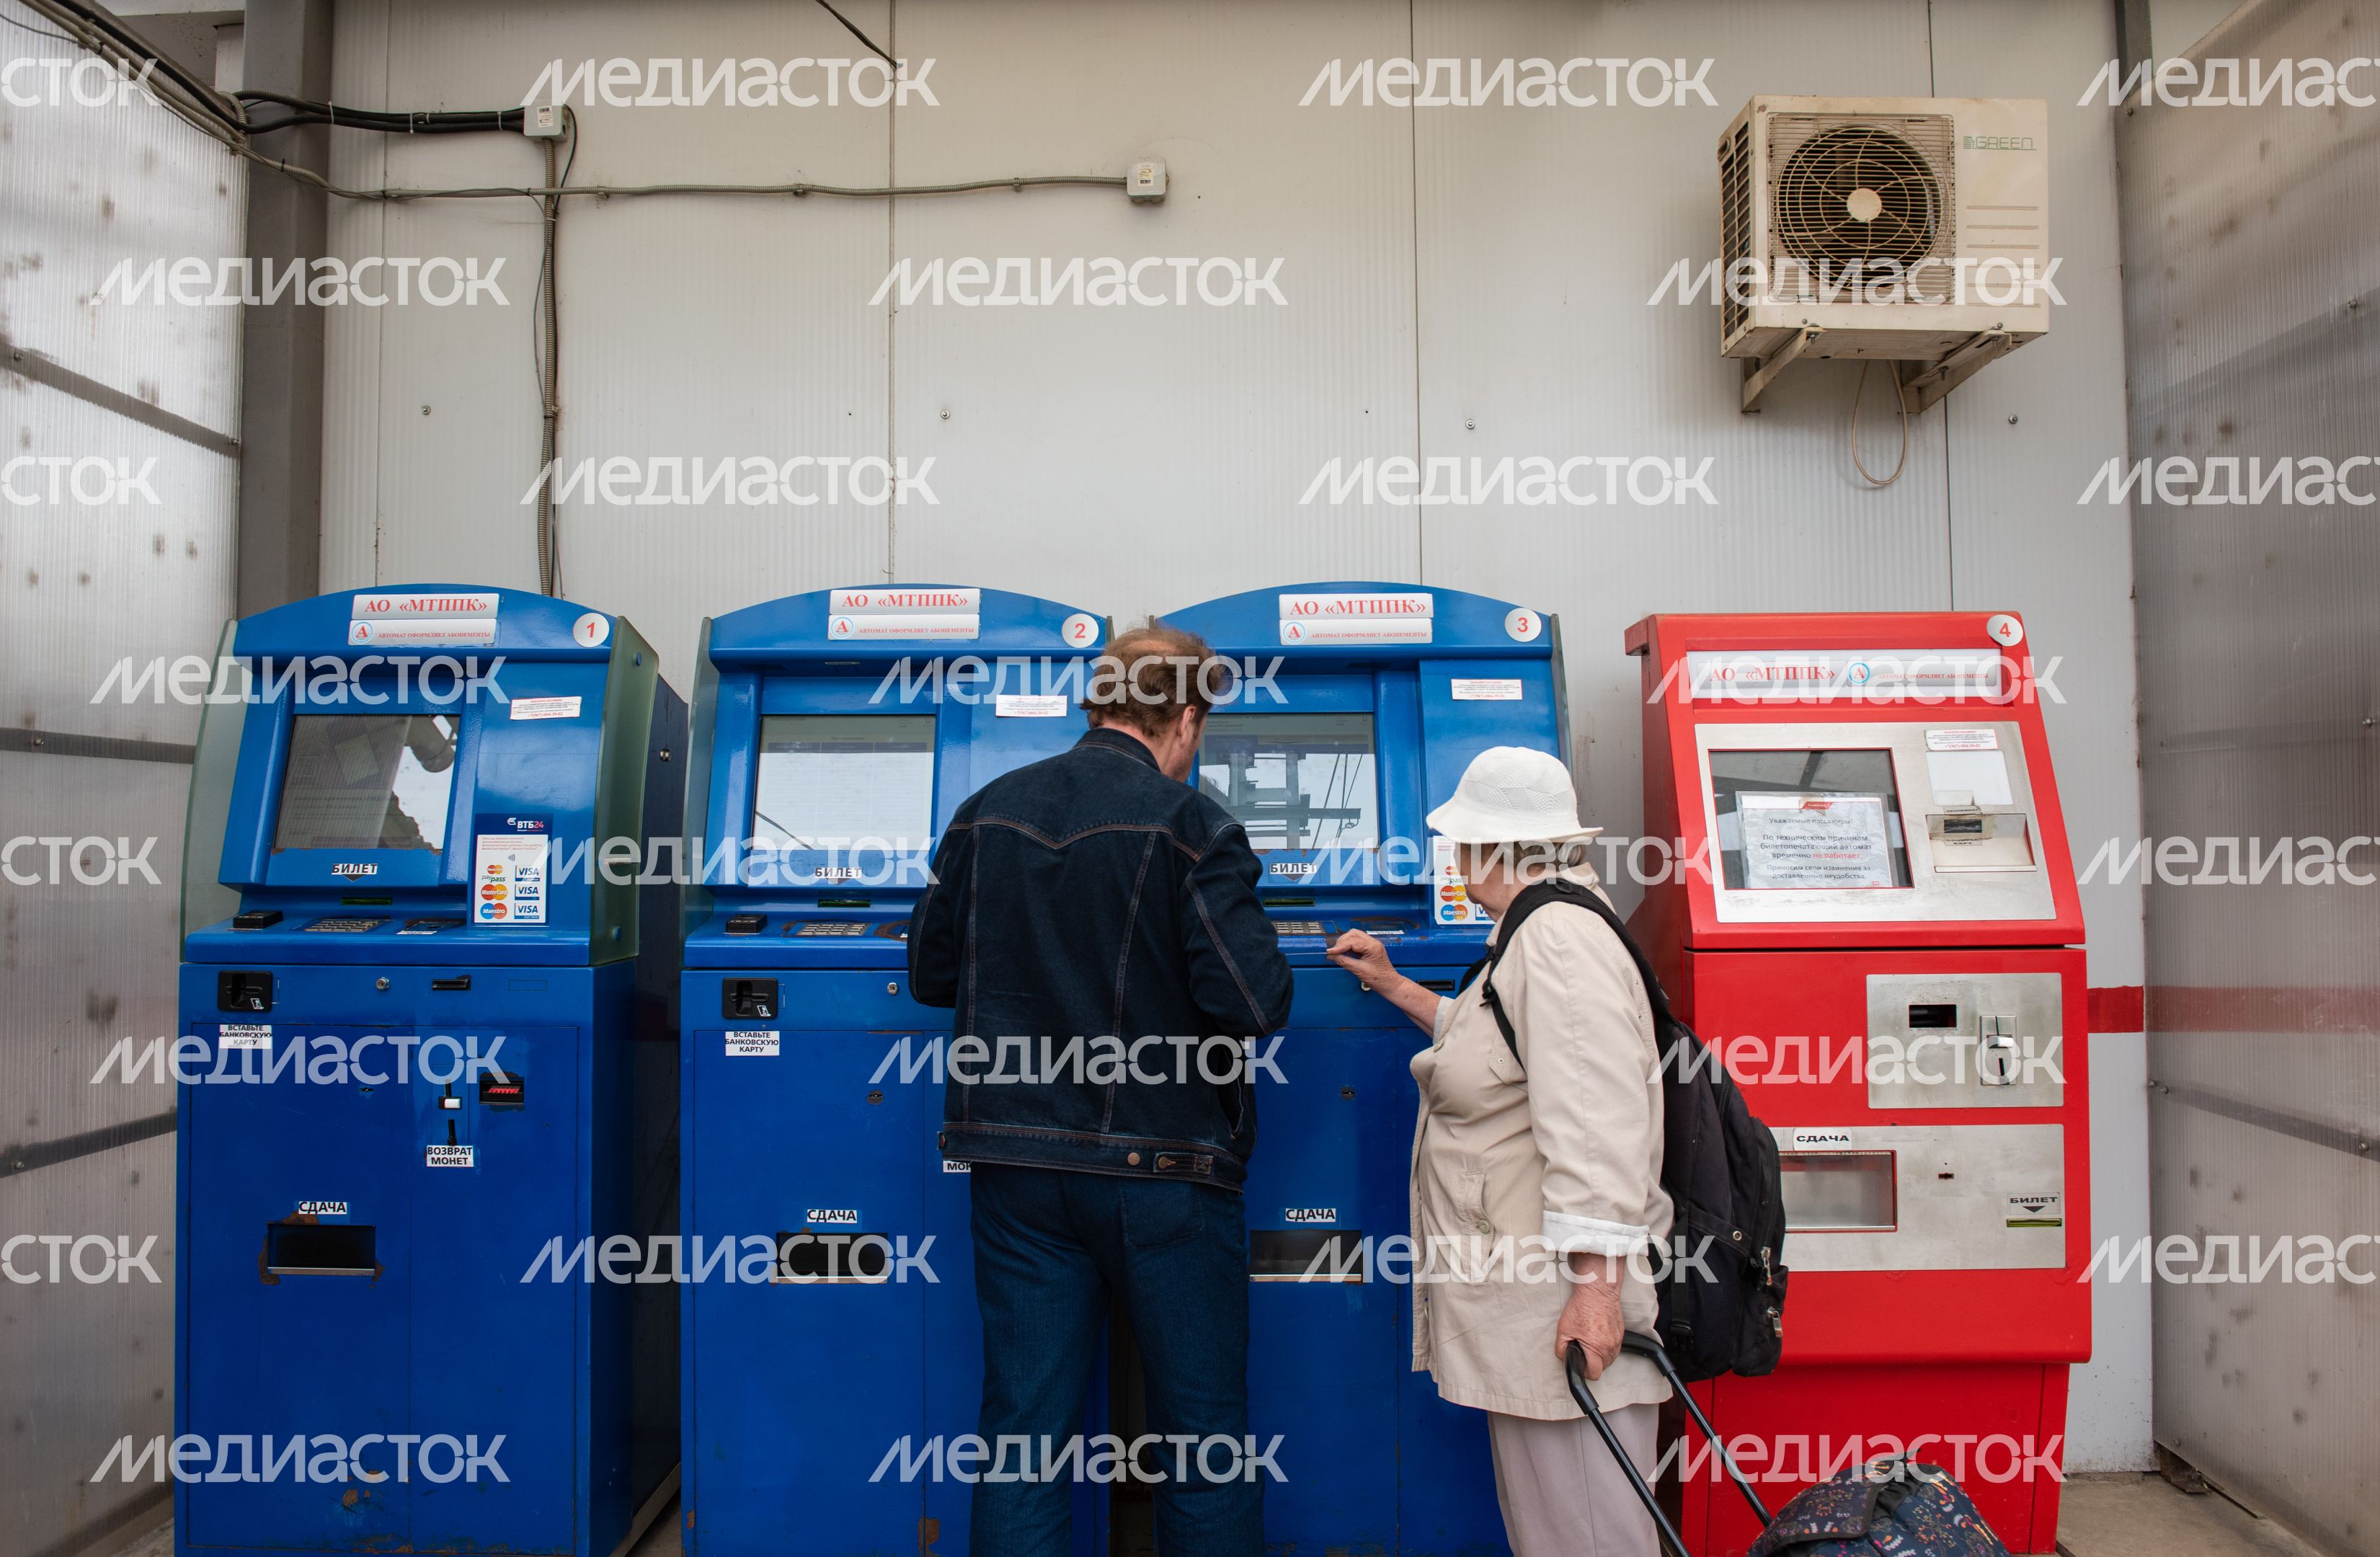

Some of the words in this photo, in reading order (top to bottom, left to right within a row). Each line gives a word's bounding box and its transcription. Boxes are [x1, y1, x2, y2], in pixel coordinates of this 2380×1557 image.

[1976, 136, 2033, 148] GREEN
[365, 599, 390, 612] АО
[399, 598, 488, 612] «МТППК»
[842, 594, 869, 607] АО
[877, 593, 968, 607] «МТППК»
[1289, 600, 1319, 616] АО
[1325, 600, 1426, 614] «МТППК»
[587, 623, 595, 638] 1
[1074, 624, 1086, 639] 2
[1517, 617, 1529, 633] 3
[1999, 623, 2011, 637] 4
[1710, 667, 1736, 681] АО
[1745, 666, 1834, 680] «МТППК»
[332, 864, 378, 874] БИЛЕТ
[814, 868, 861, 877] БИЛЕТ
[518, 886, 538, 895] VISA
[1795, 1135, 1850, 1143] СДАЧА
[427, 1147, 473, 1155] ВОЗВРАТ
[298, 1202, 347, 1214] СДАЧА
[807, 1210, 856, 1223] СДАЧА
[1286, 1209, 1336, 1222] СДАЧА
